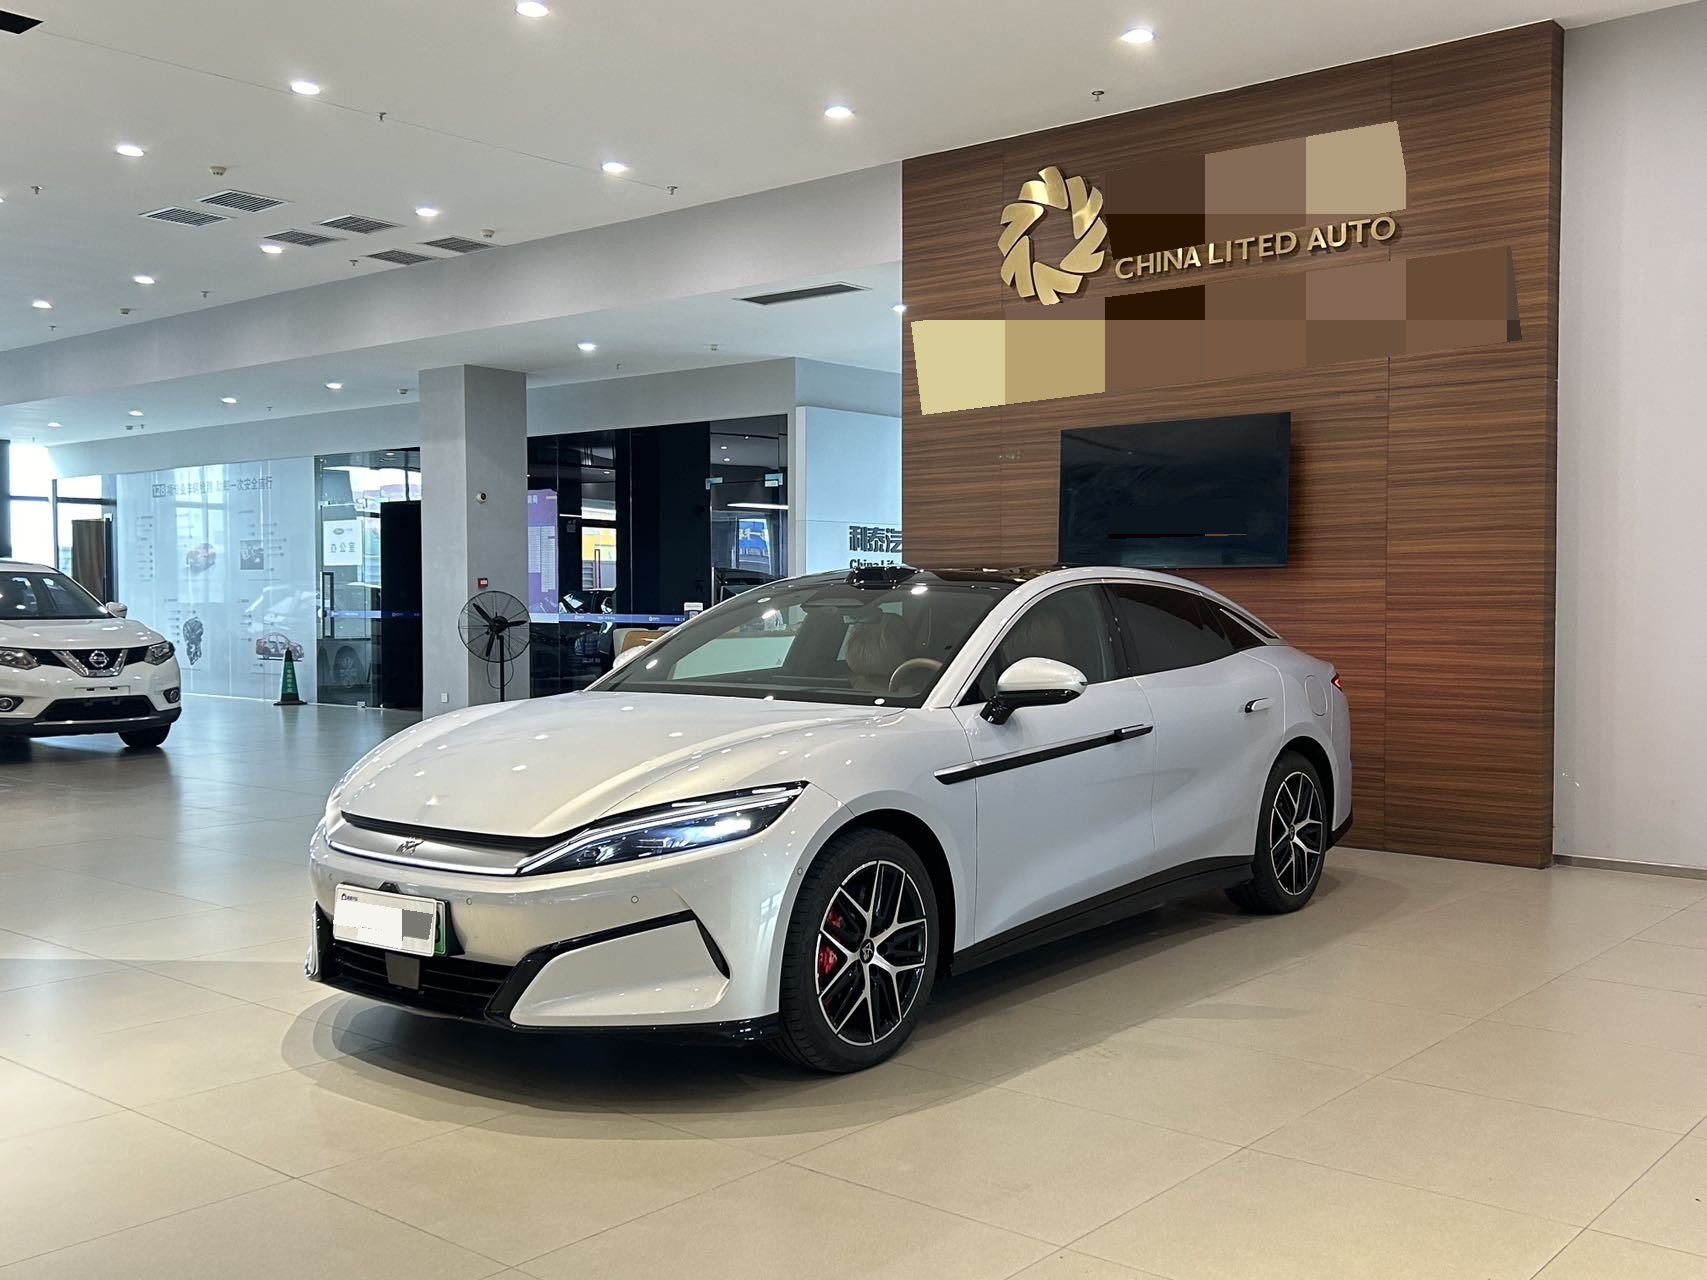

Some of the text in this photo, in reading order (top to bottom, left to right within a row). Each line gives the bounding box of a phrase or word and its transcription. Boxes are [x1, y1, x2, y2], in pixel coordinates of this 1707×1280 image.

[1115, 216, 1397, 280] CHINA LITED AUTO
